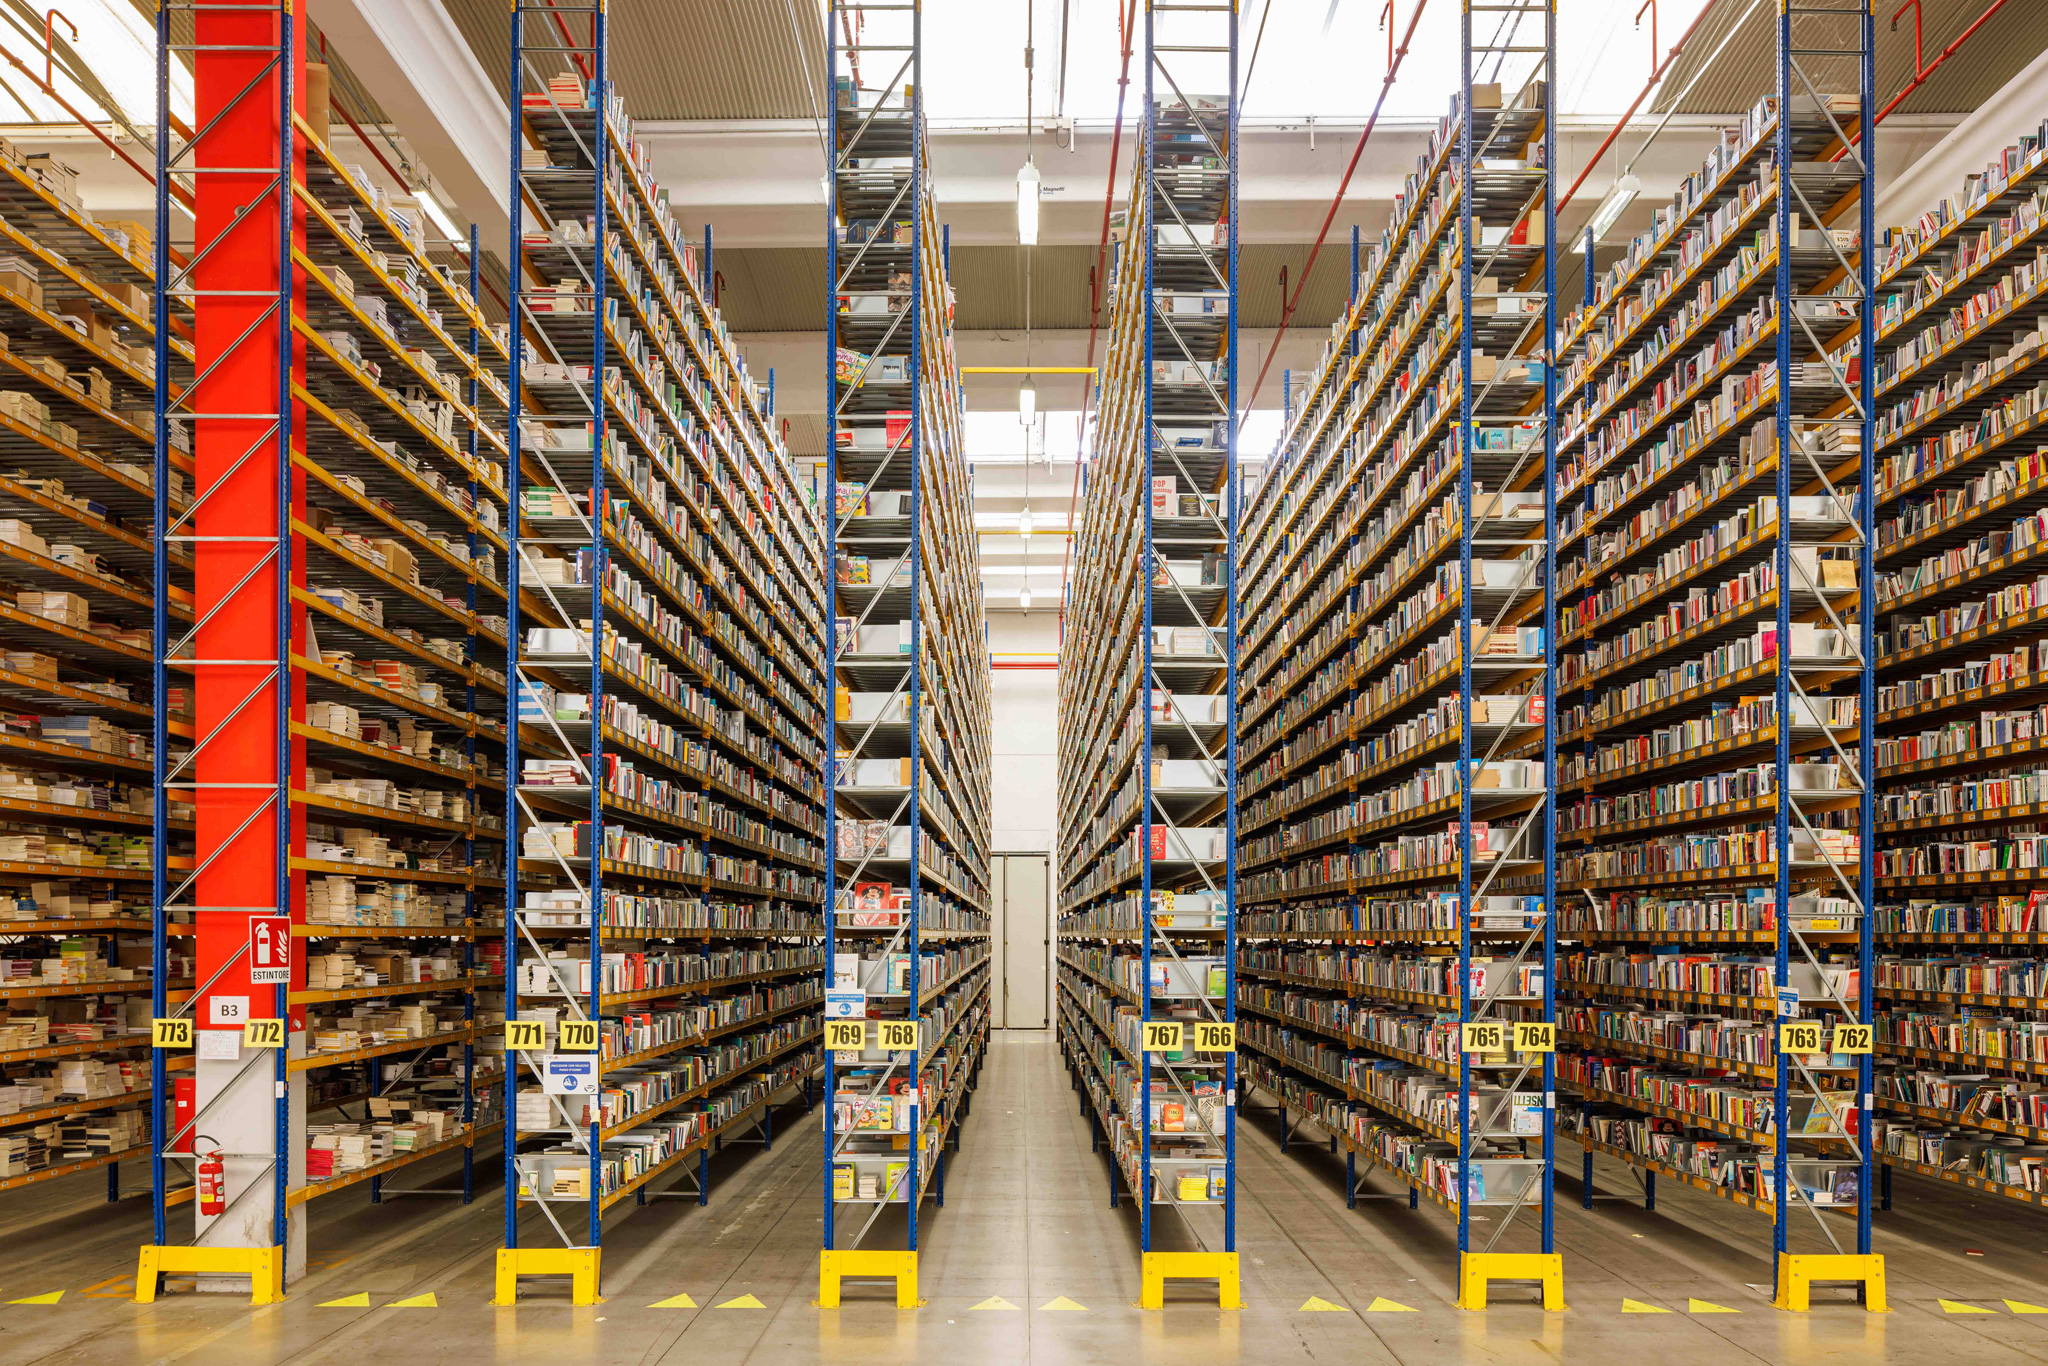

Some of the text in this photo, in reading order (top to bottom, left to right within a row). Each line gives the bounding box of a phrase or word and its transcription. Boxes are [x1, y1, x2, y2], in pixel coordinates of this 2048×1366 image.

[252, 970, 290, 980] ESTINTORE
[221, 1004, 238, 1016] B3
[158, 1022, 188, 1042] 773
[250, 1022, 280, 1043] 772
[511, 1024, 542, 1045] 771
[565, 1024, 594, 1045] 770
[830, 1024, 861, 1045] 769
[883, 1025, 914, 1045] 768
[1148, 1026, 1179, 1046] 767
[1200, 1026, 1231, 1047] 766
[1468, 1027, 1500, 1047] 765
[1519, 1026, 1551, 1047] 764
[1785, 1028, 1817, 1049] 763
[1839, 1028, 1869, 1049] 762
[1513, 1095, 1544, 1106] NSETTI
